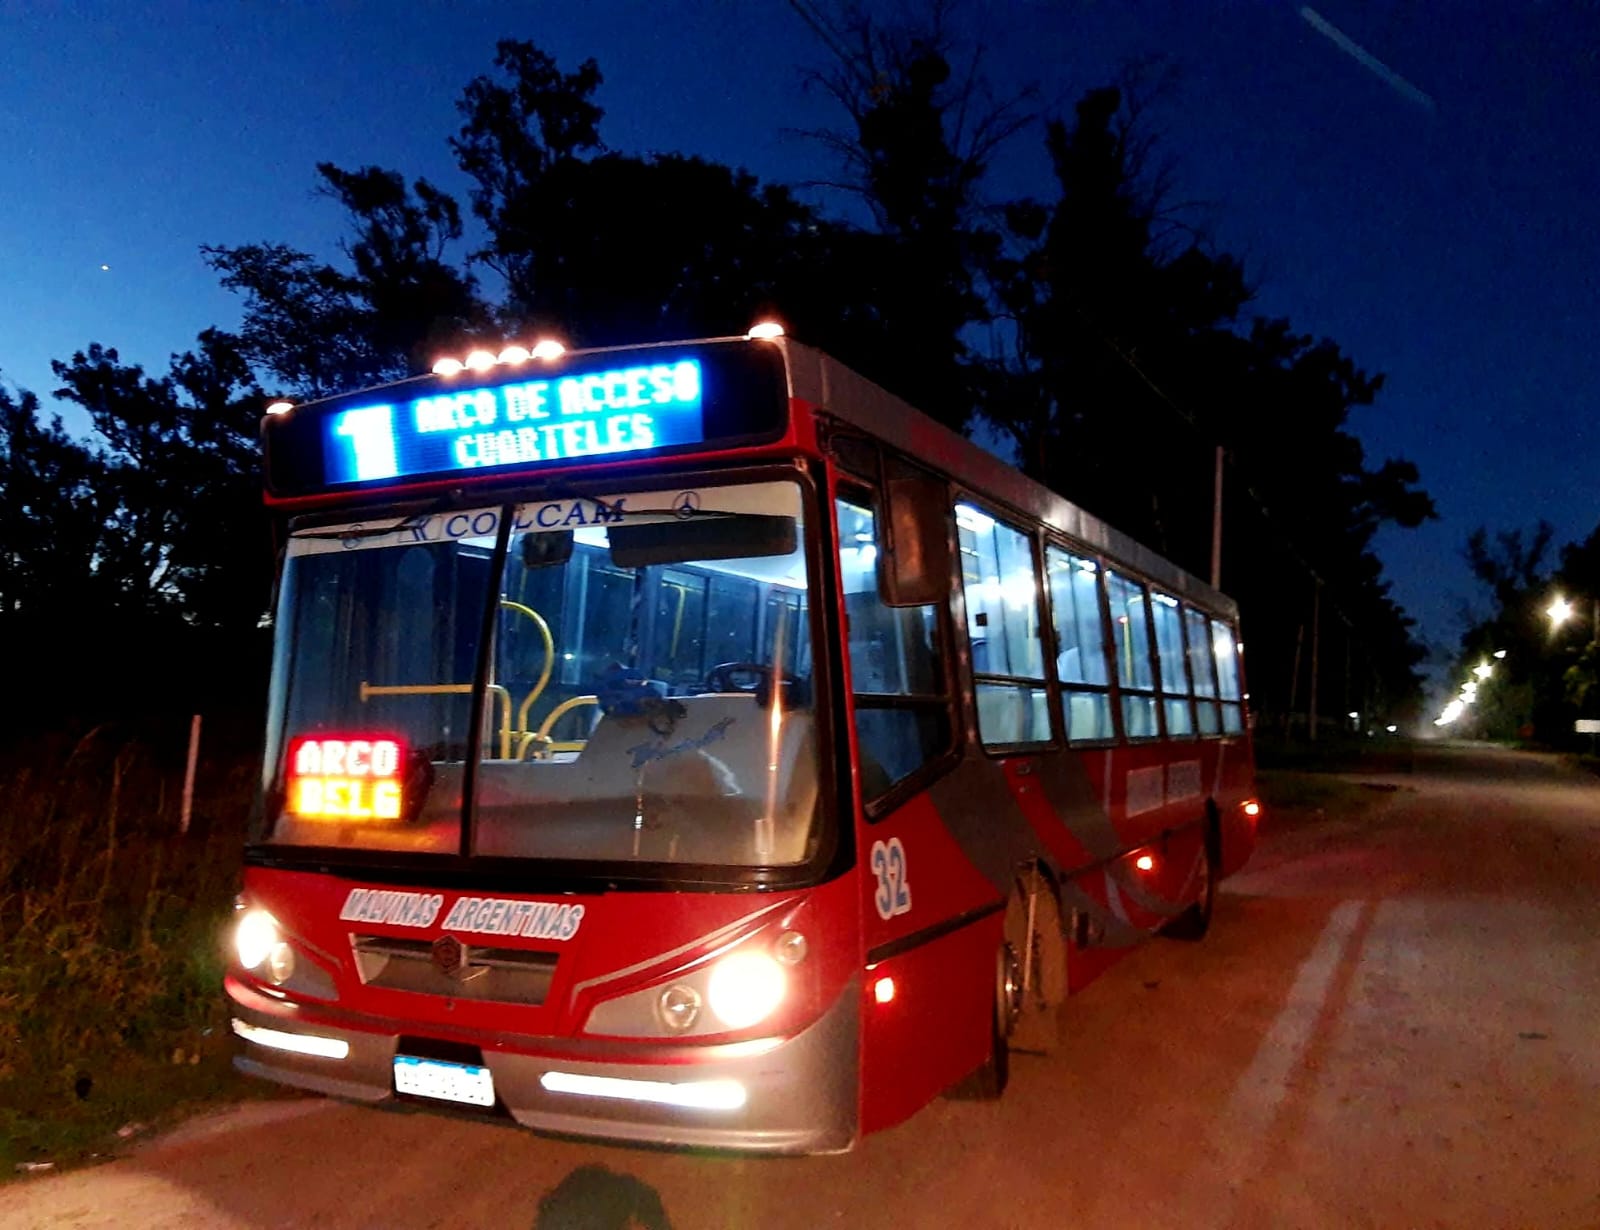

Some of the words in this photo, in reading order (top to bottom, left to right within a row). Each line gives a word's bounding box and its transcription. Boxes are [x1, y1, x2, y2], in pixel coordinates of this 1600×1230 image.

[417, 391, 496, 432] ARCO
[506, 384, 548, 421] DE
[560, 362, 699, 413] ACCESO
[338, 406, 397, 480] 1
[457, 414, 654, 467] CUARTELES
[297, 740, 398, 776] ARCO
[870, 837, 912, 920] 32
[441, 896, 585, 941] ARGENTINAS
